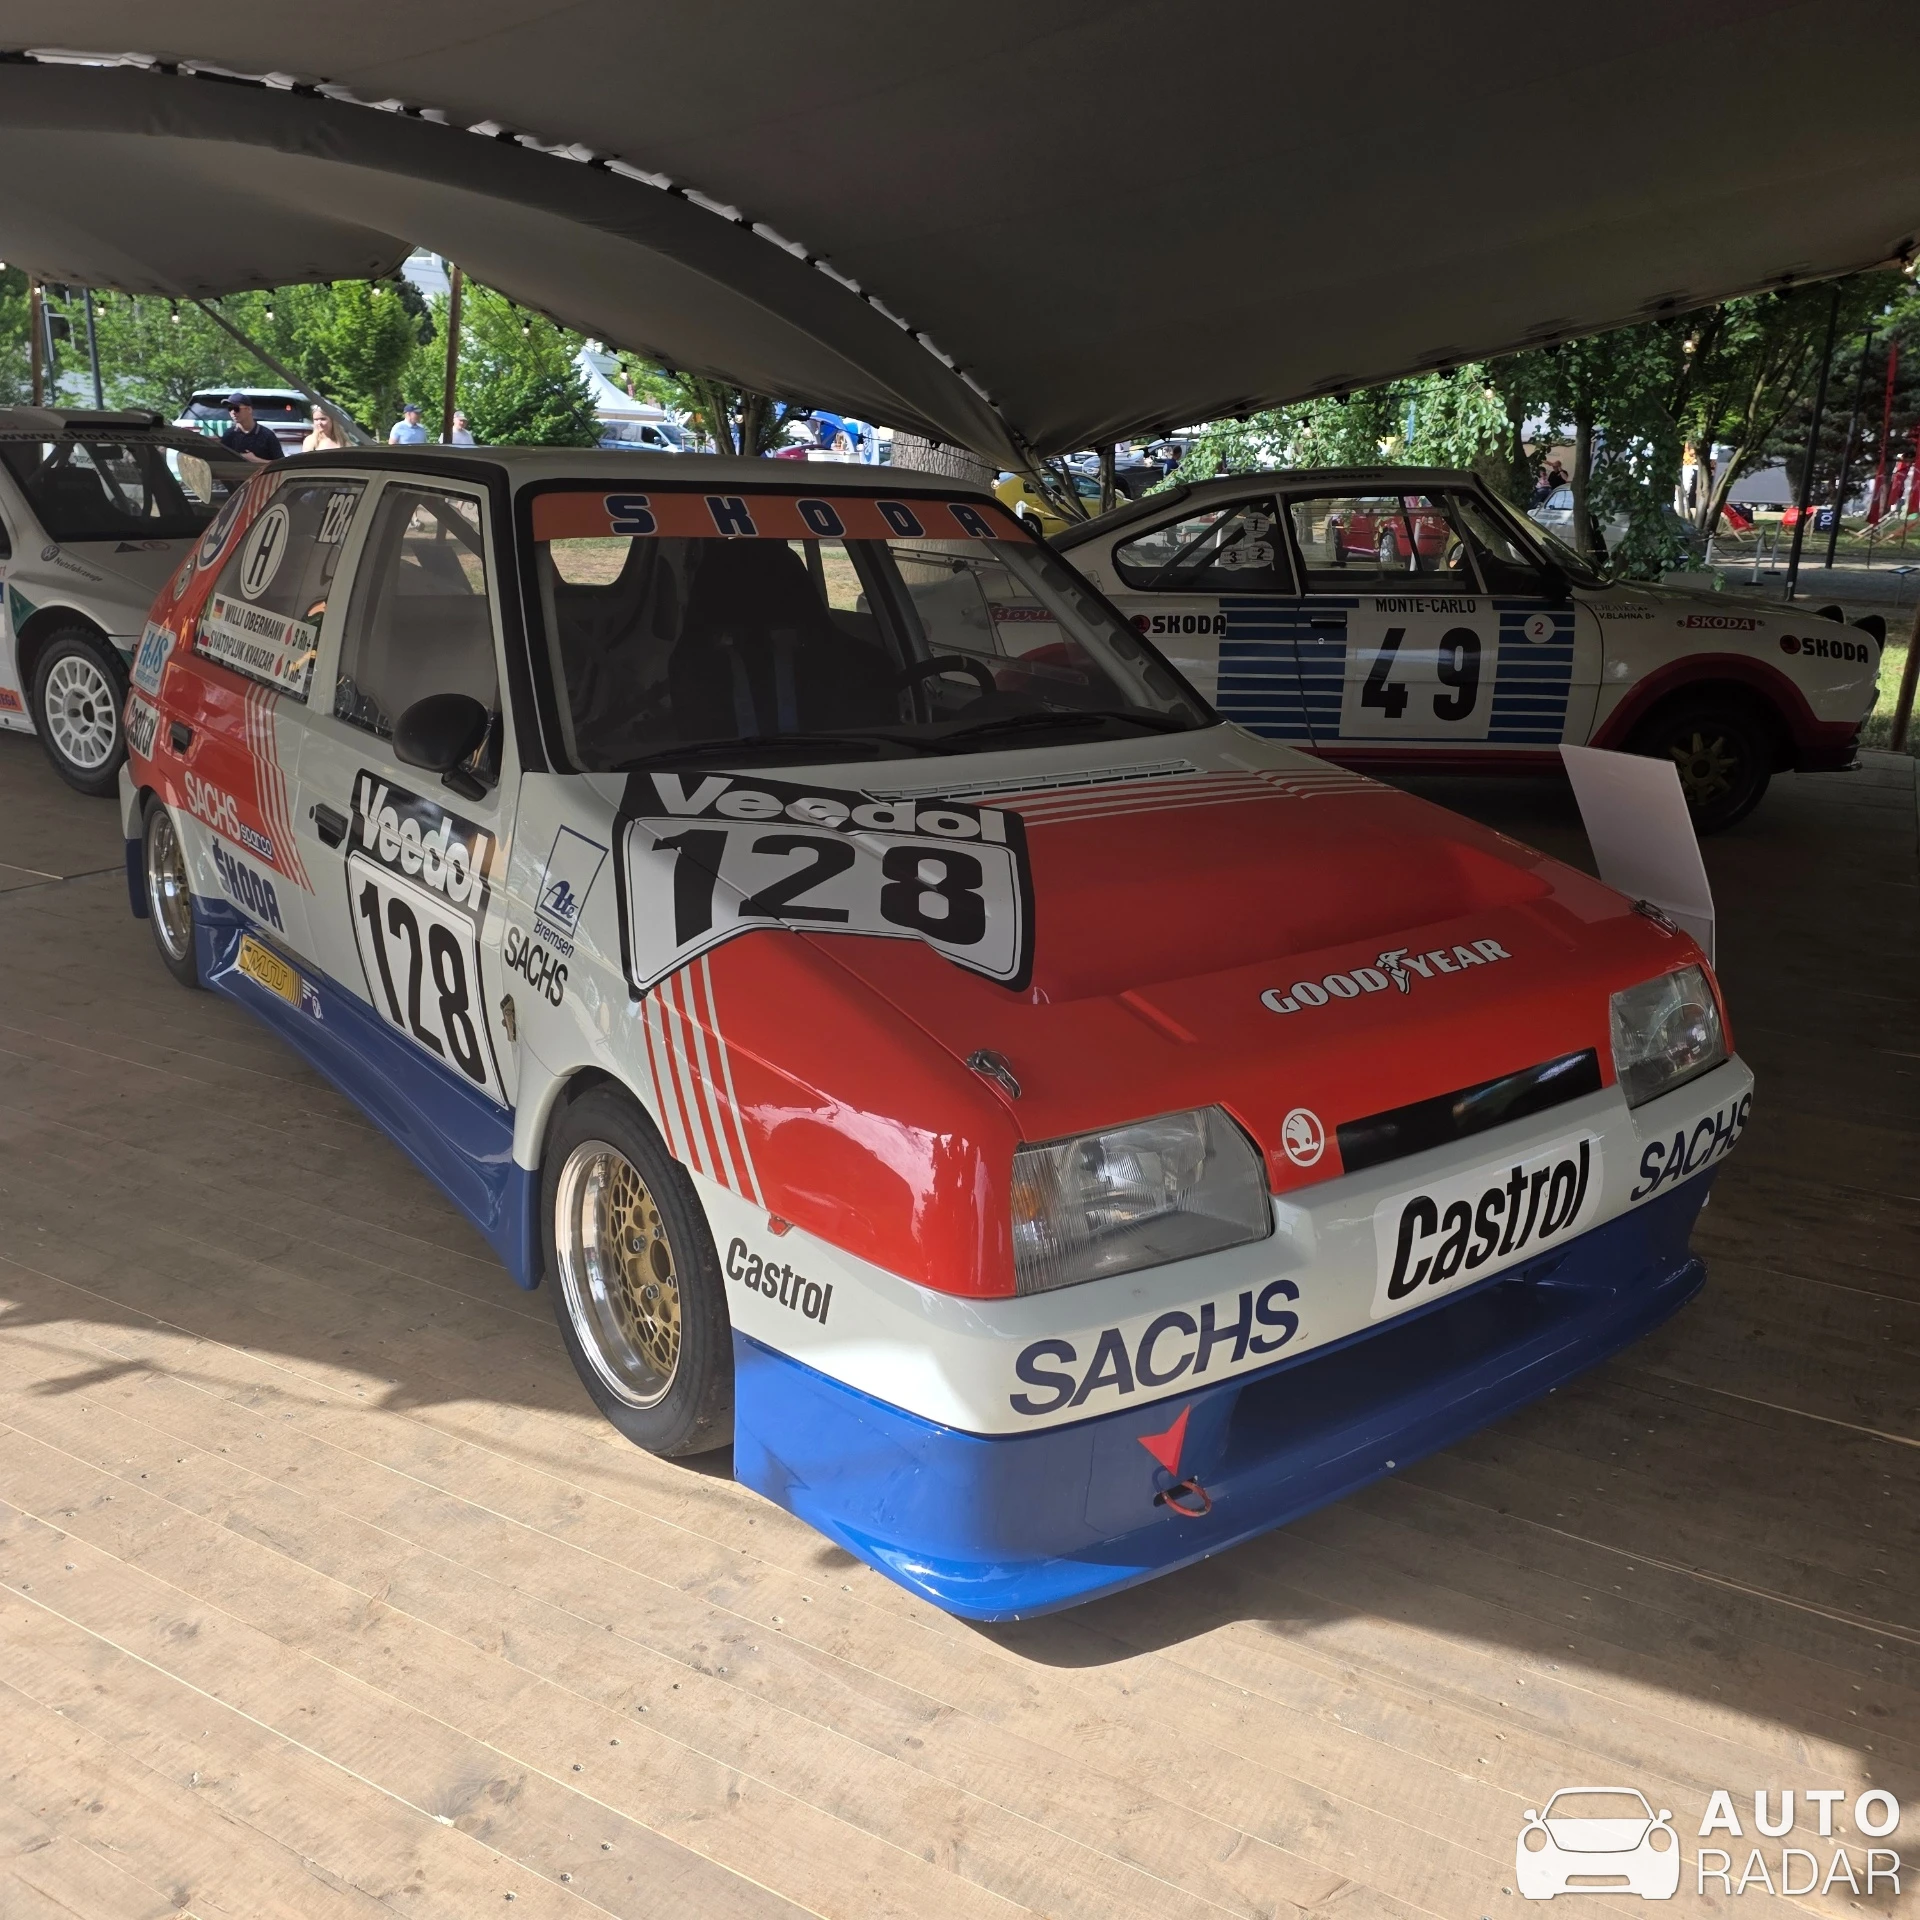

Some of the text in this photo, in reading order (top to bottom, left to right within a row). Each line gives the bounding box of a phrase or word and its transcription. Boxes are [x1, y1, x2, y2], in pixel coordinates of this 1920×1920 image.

[318, 493, 354, 544] 128
[603, 493, 998, 539] SKODA
[247, 516, 282, 588] H
[224, 603, 245, 628] WILLI
[243, 611, 286, 642] OBERMANN
[1152, 615, 1226, 634] SKODA
[1375, 599, 1477, 614] MONTE-CARLO
[1534, 621, 1544, 635] 2
[1690, 616, 1752, 630] SKODA
[208, 629, 245, 661] SVATOPLUK
[243, 644, 275, 673] KVAIZAR
[1801, 637, 1869, 664] SKODA
[184, 771, 241, 841] SACHS
[240, 823, 272, 855] sparco
[650, 772, 1006, 843] Veedol
[360, 775, 489, 912] Veedol
[212, 835, 285, 933] ŠKODA
[652, 829, 986, 948] 128
[504, 926, 568, 1007] SACHS
[534, 918, 575, 959] Bremsen
[359, 880, 487, 1085] 128
[1629, 1093, 1752, 1202] SACHS
[1387, 1138, 1590, 1300] Castrol
[726, 1237, 833, 1325] Castrol
[1009, 1279, 1300, 1415] SACHS
